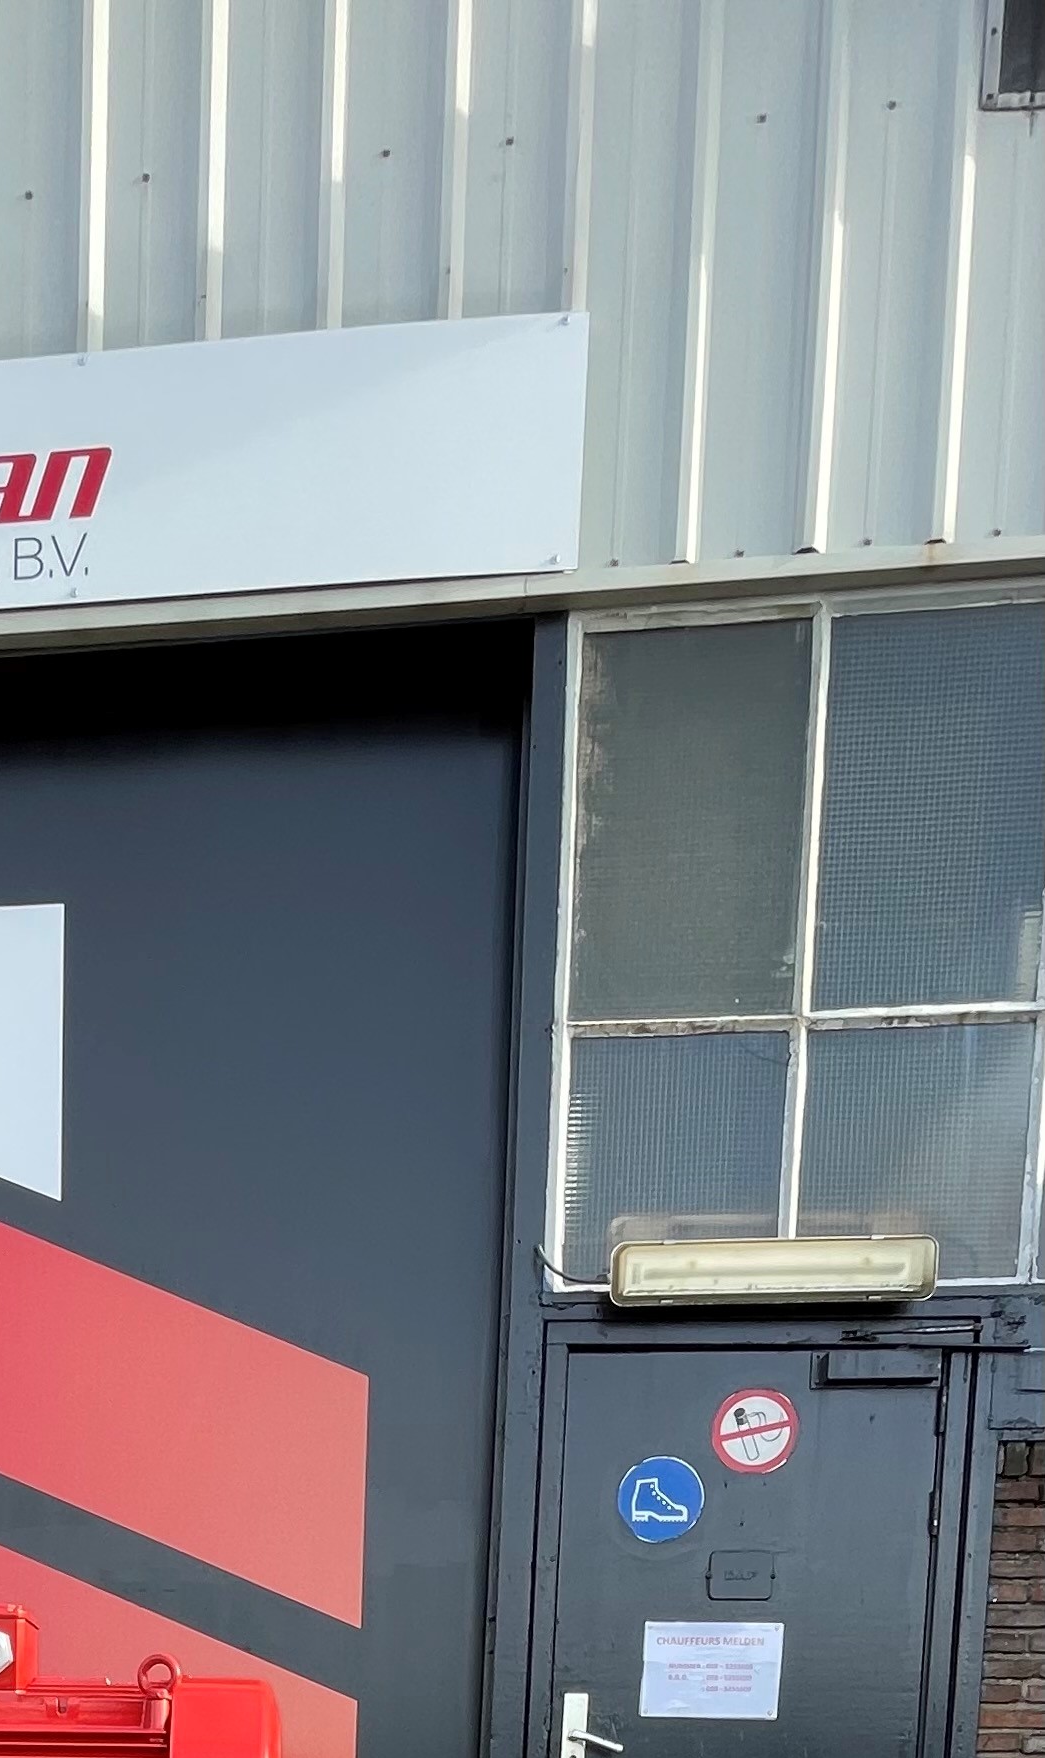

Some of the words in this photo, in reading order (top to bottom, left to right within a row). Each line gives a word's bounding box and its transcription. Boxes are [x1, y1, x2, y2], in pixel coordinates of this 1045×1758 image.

[13, 533, 90, 581] B.V.
[656, 1636, 720, 1646] CHAUFFEURS
[723, 1636, 765, 1646] MELDEN
